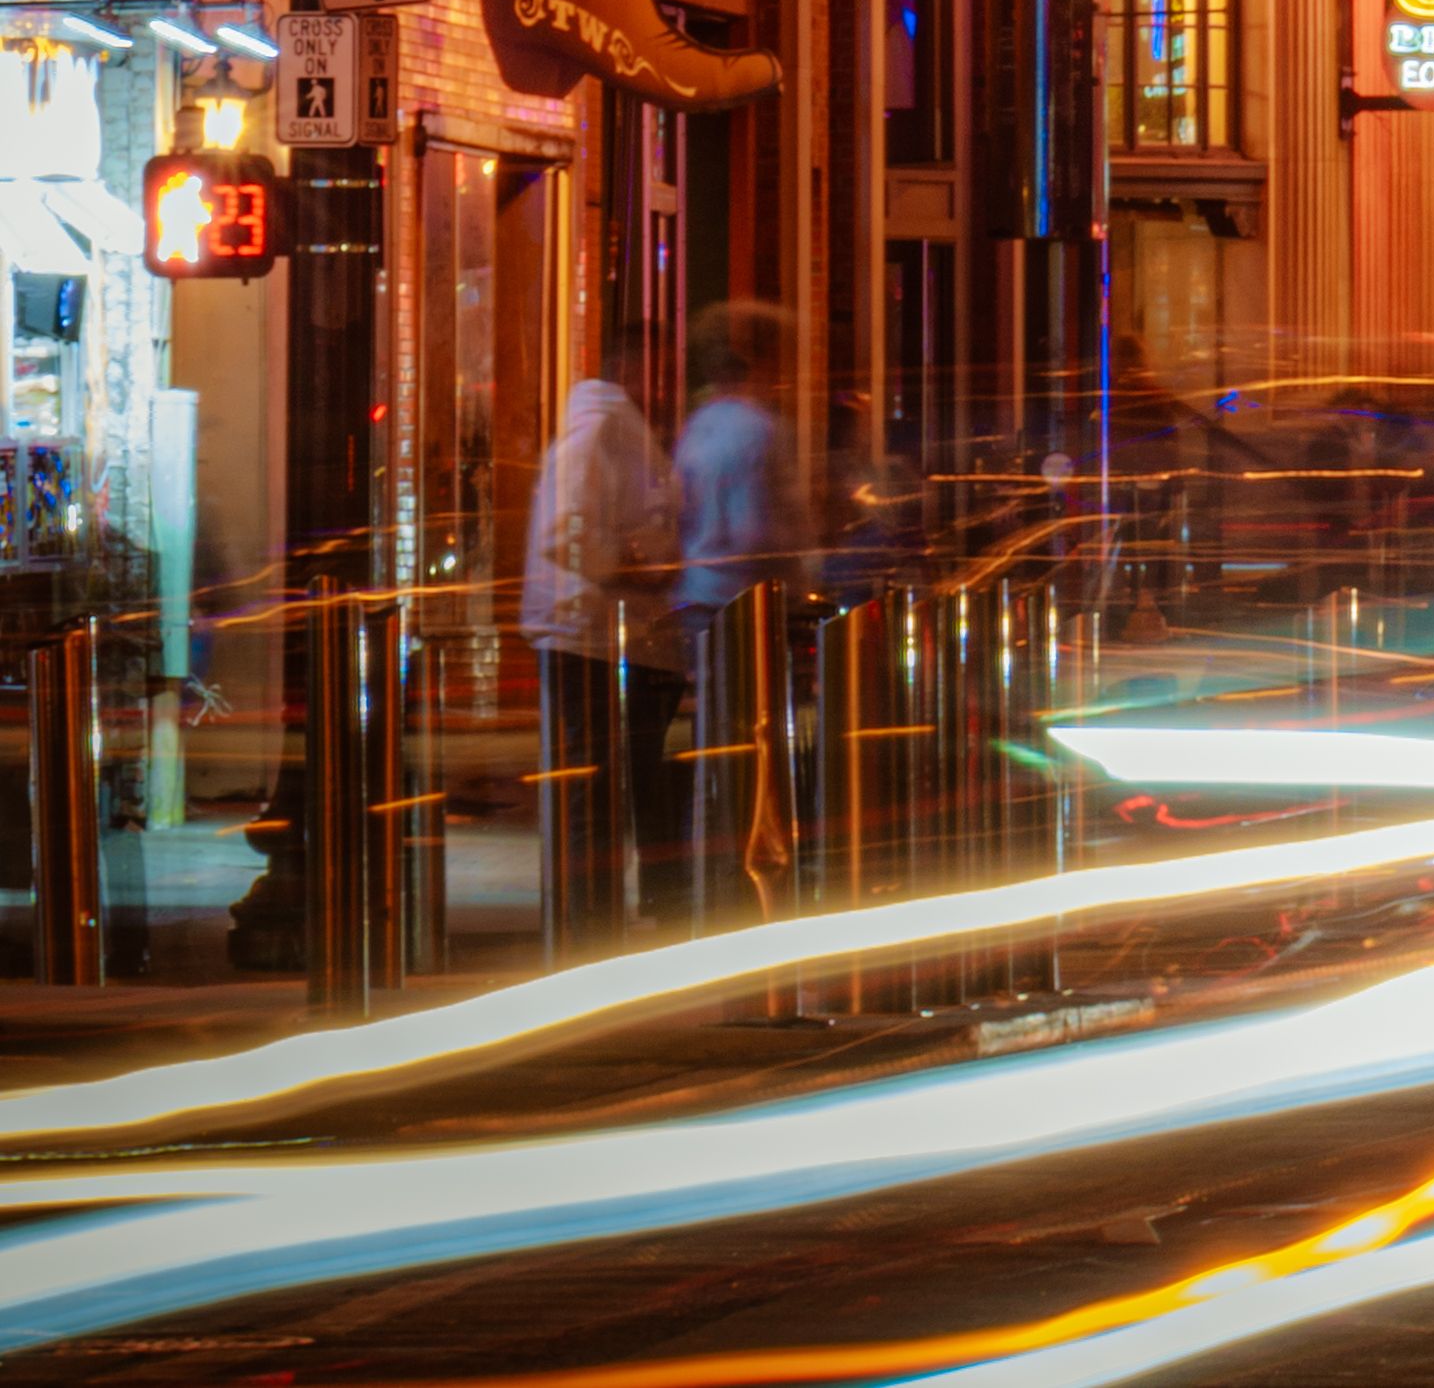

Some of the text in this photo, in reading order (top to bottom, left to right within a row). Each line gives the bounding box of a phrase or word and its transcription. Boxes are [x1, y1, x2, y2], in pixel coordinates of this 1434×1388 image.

[288, 18, 343, 37] CROSS
[293, 39, 337, 56] ONLY
[304, 57, 328, 74] ON
[287, 121, 341, 138] SIGNAL
